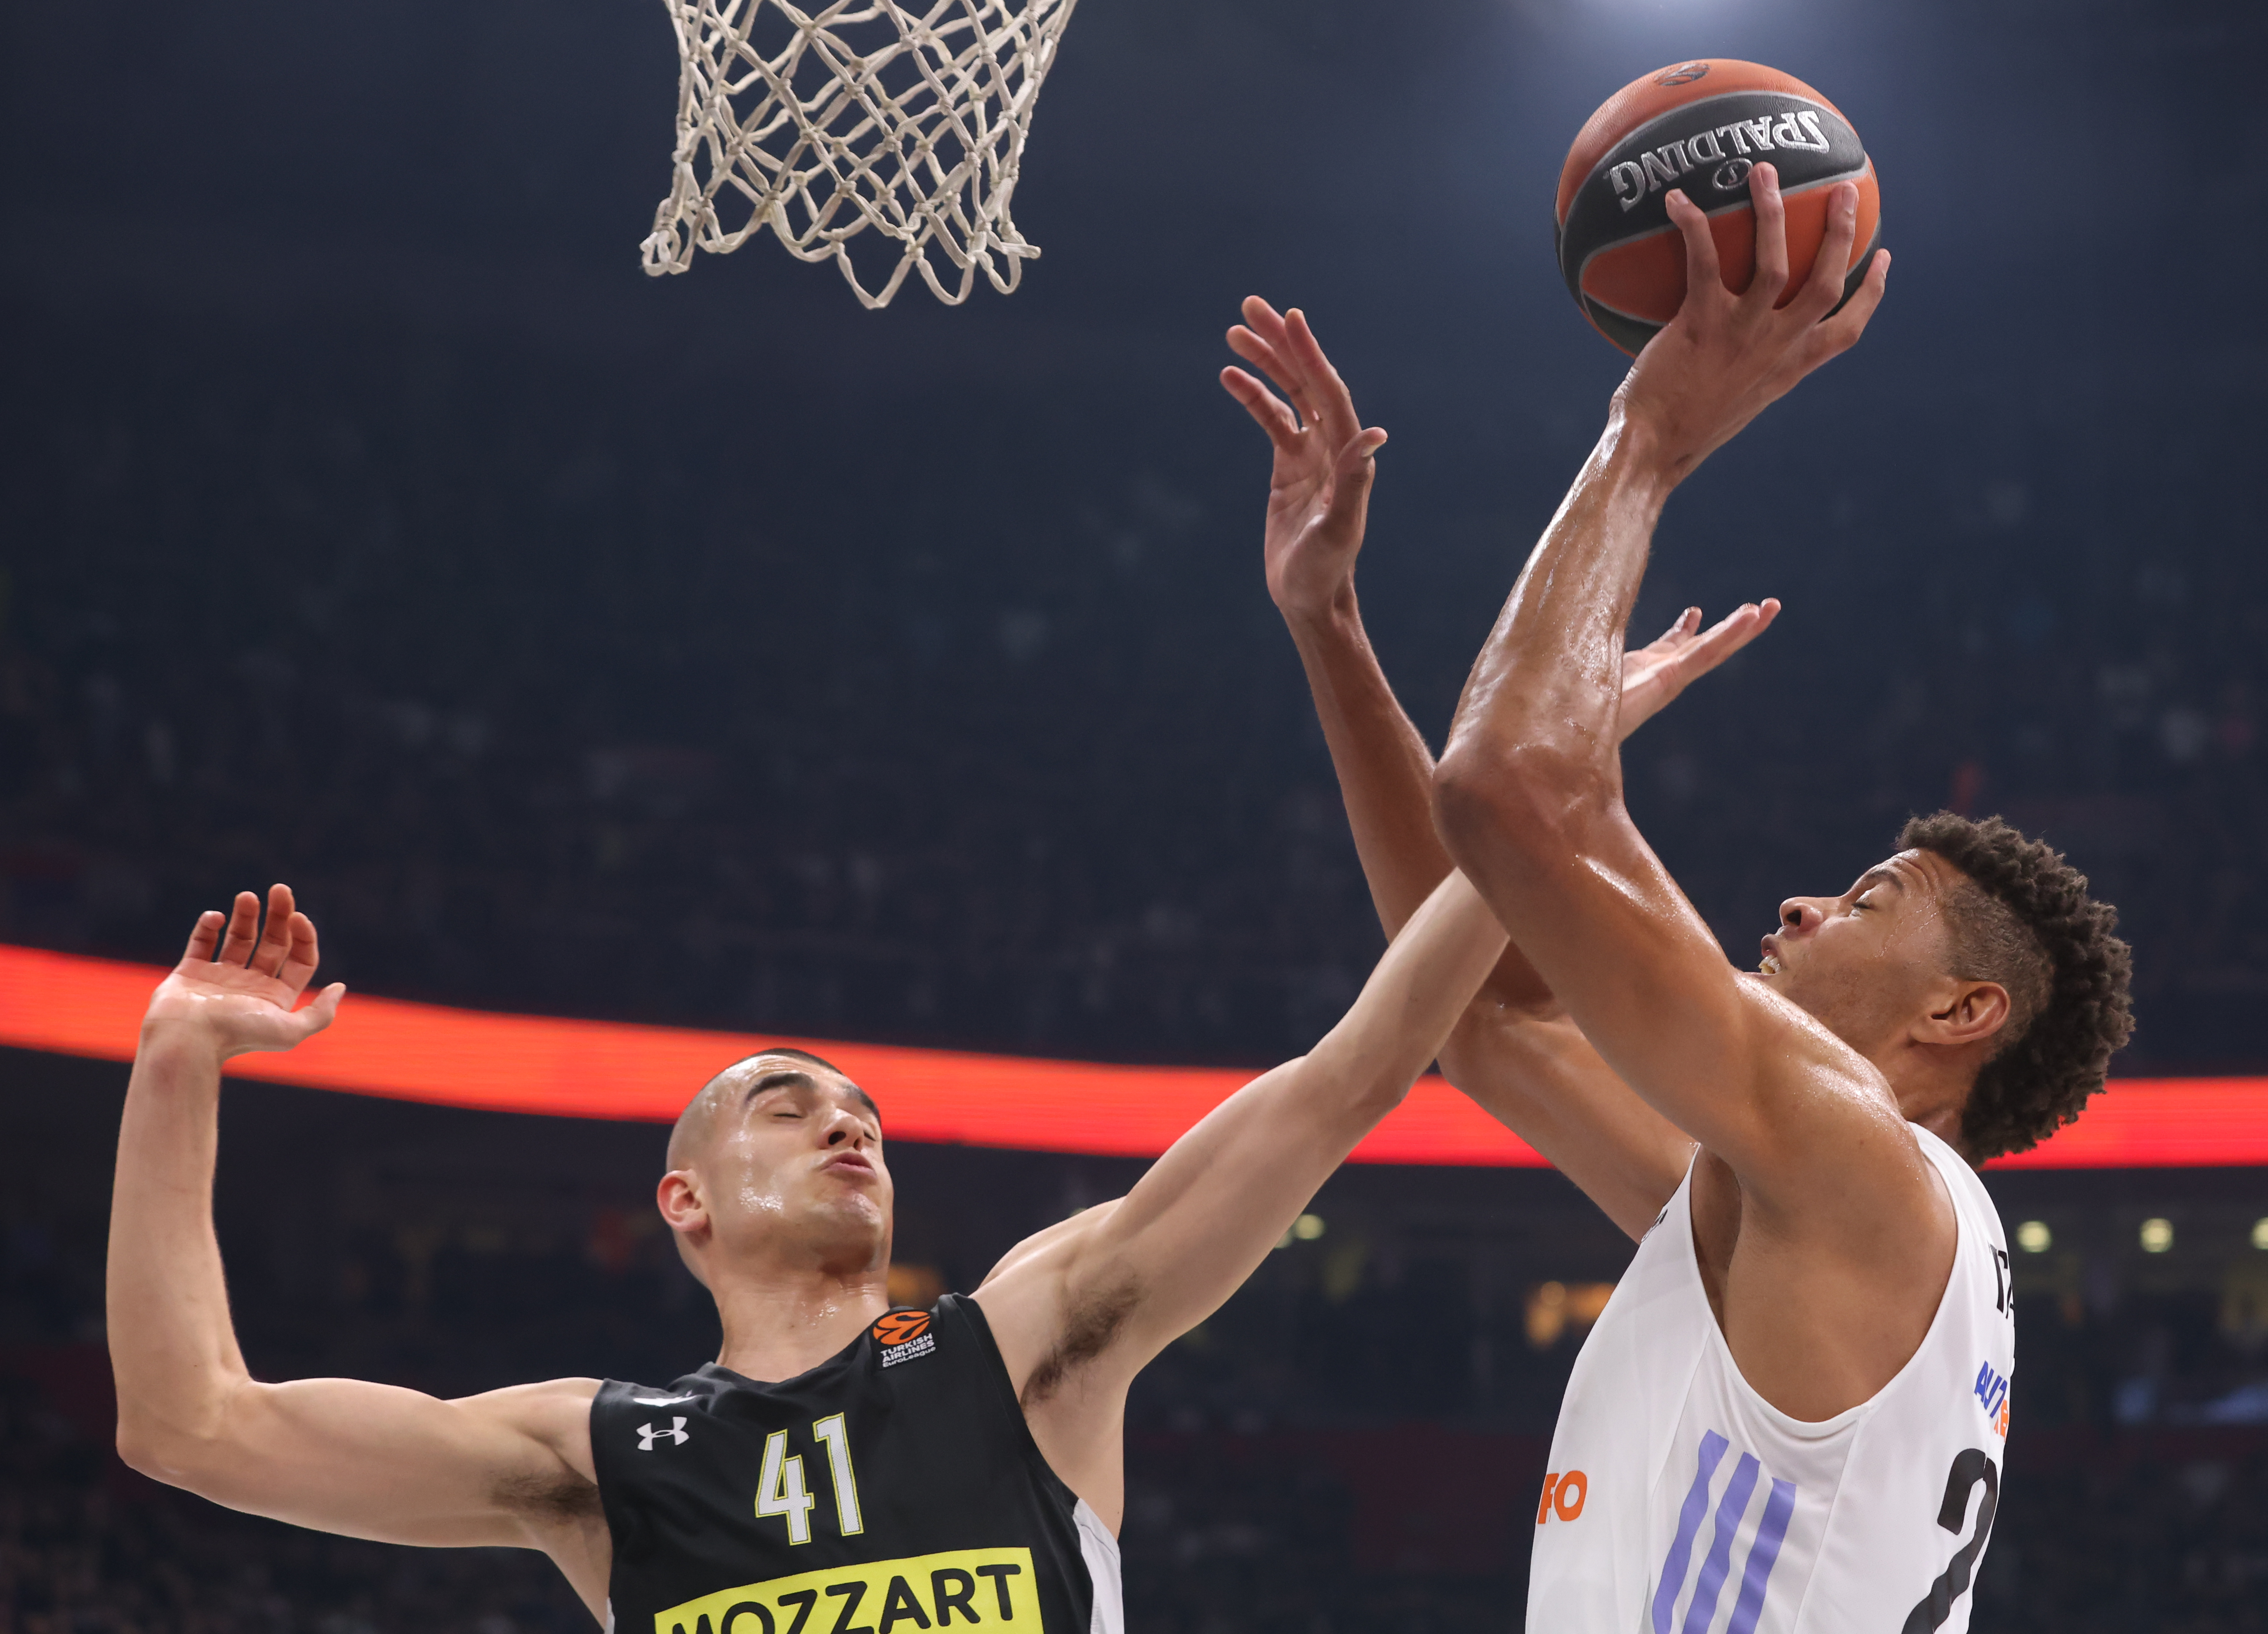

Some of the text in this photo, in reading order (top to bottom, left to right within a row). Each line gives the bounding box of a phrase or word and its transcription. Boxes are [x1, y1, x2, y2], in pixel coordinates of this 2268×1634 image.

[1604, 110, 1830, 212] SPALDING
[880, 1332, 933, 1357] TURKISH
[882, 1339, 934, 1363] AIRLINES
[754, 1411, 864, 1546] 41
[672, 1563, 1021, 1634] OZZART
